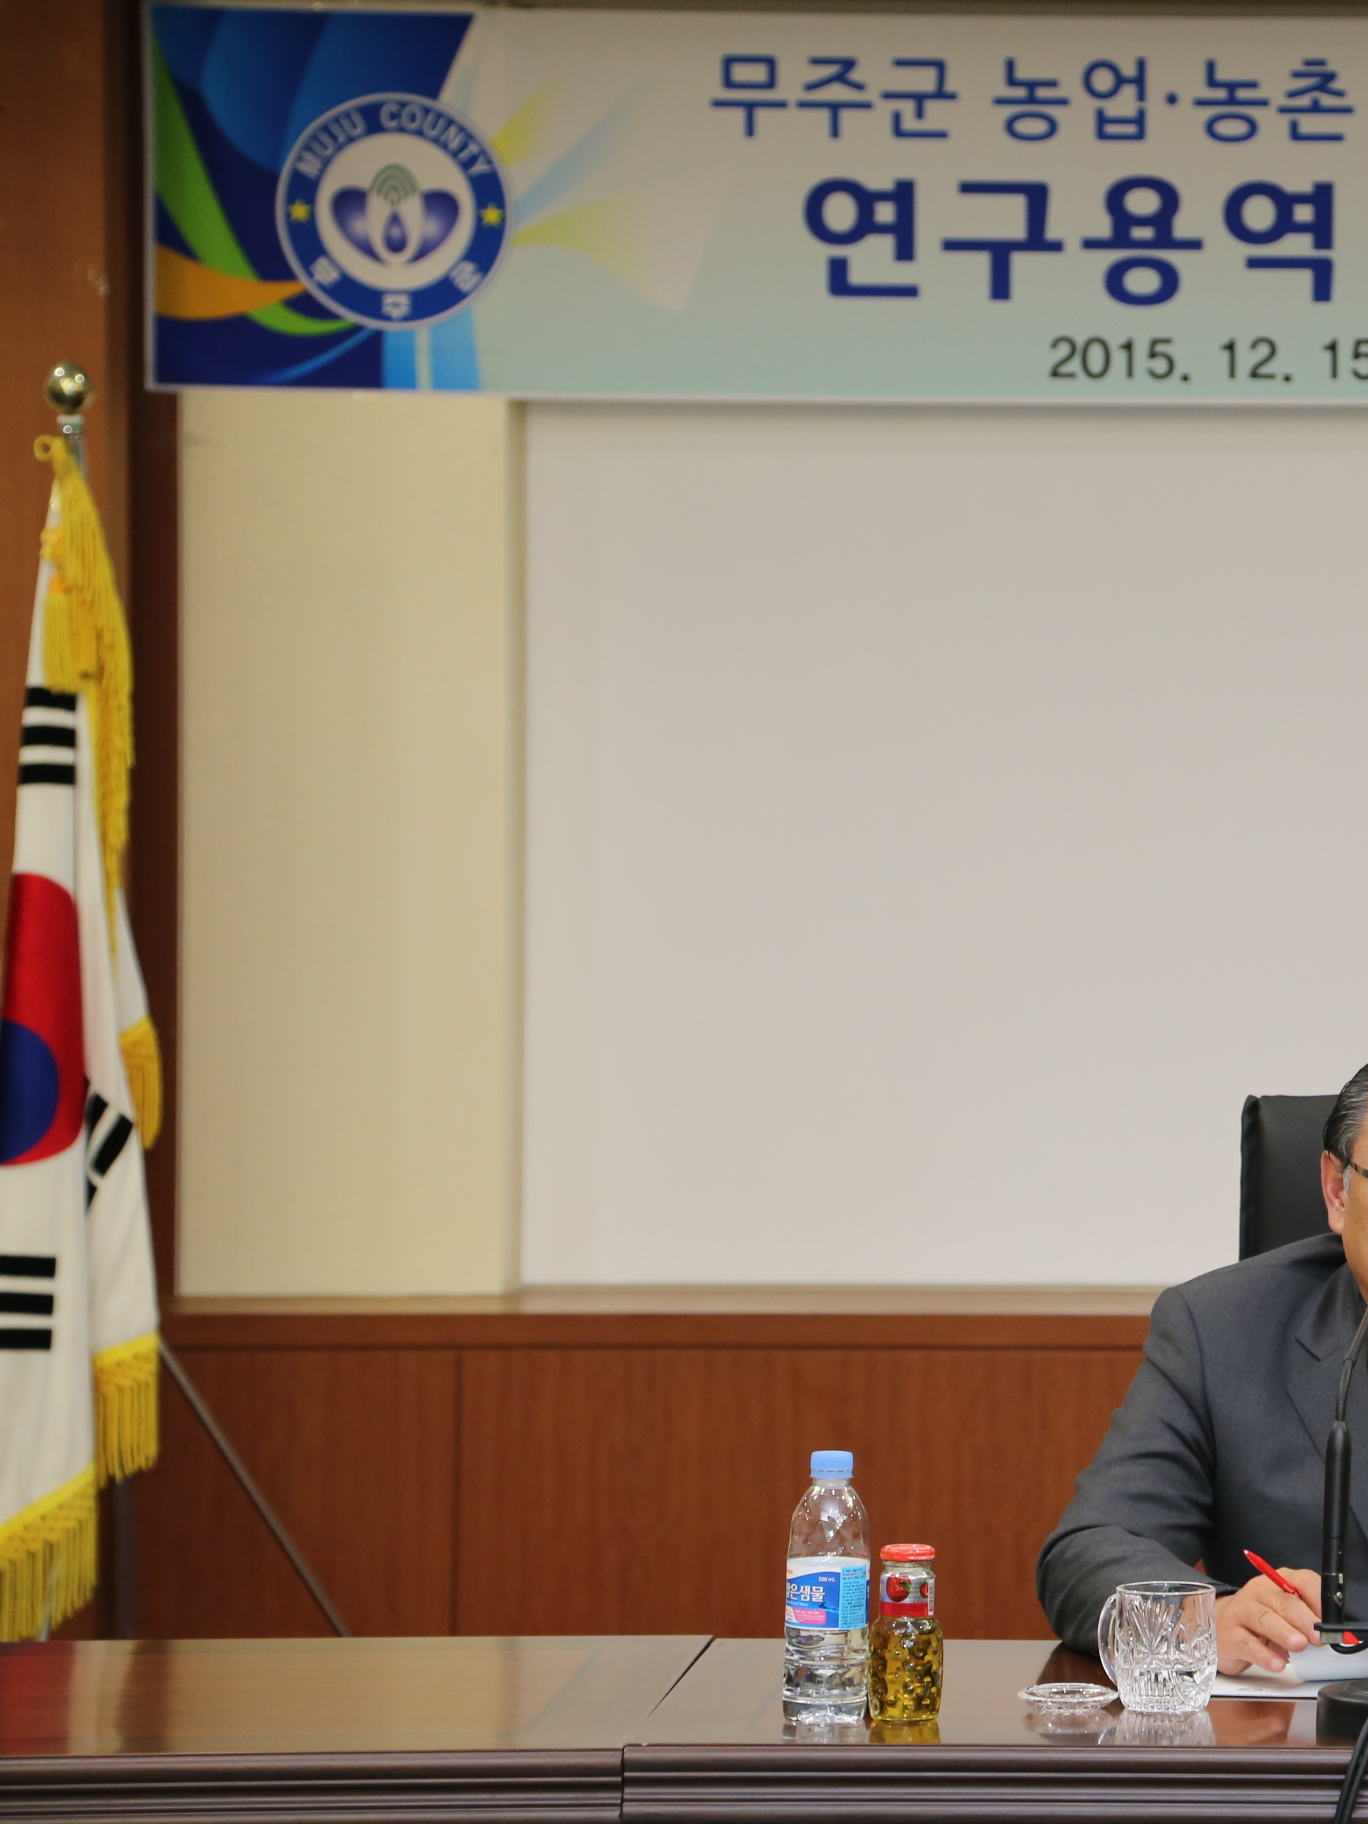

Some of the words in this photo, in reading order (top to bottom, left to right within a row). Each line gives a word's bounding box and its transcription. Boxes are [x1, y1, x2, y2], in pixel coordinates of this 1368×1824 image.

[294, 109, 367, 181] MUJU
[379, 101, 493, 178] COUNTY
[709, 53, 959, 140] 무주군
[991, 56, 1355, 144] 농업·농촌
[802, 174, 1335, 307] 연구용역
[1049, 335, 1190, 382] 2015.
[1220, 336, 1293, 383] 12.
